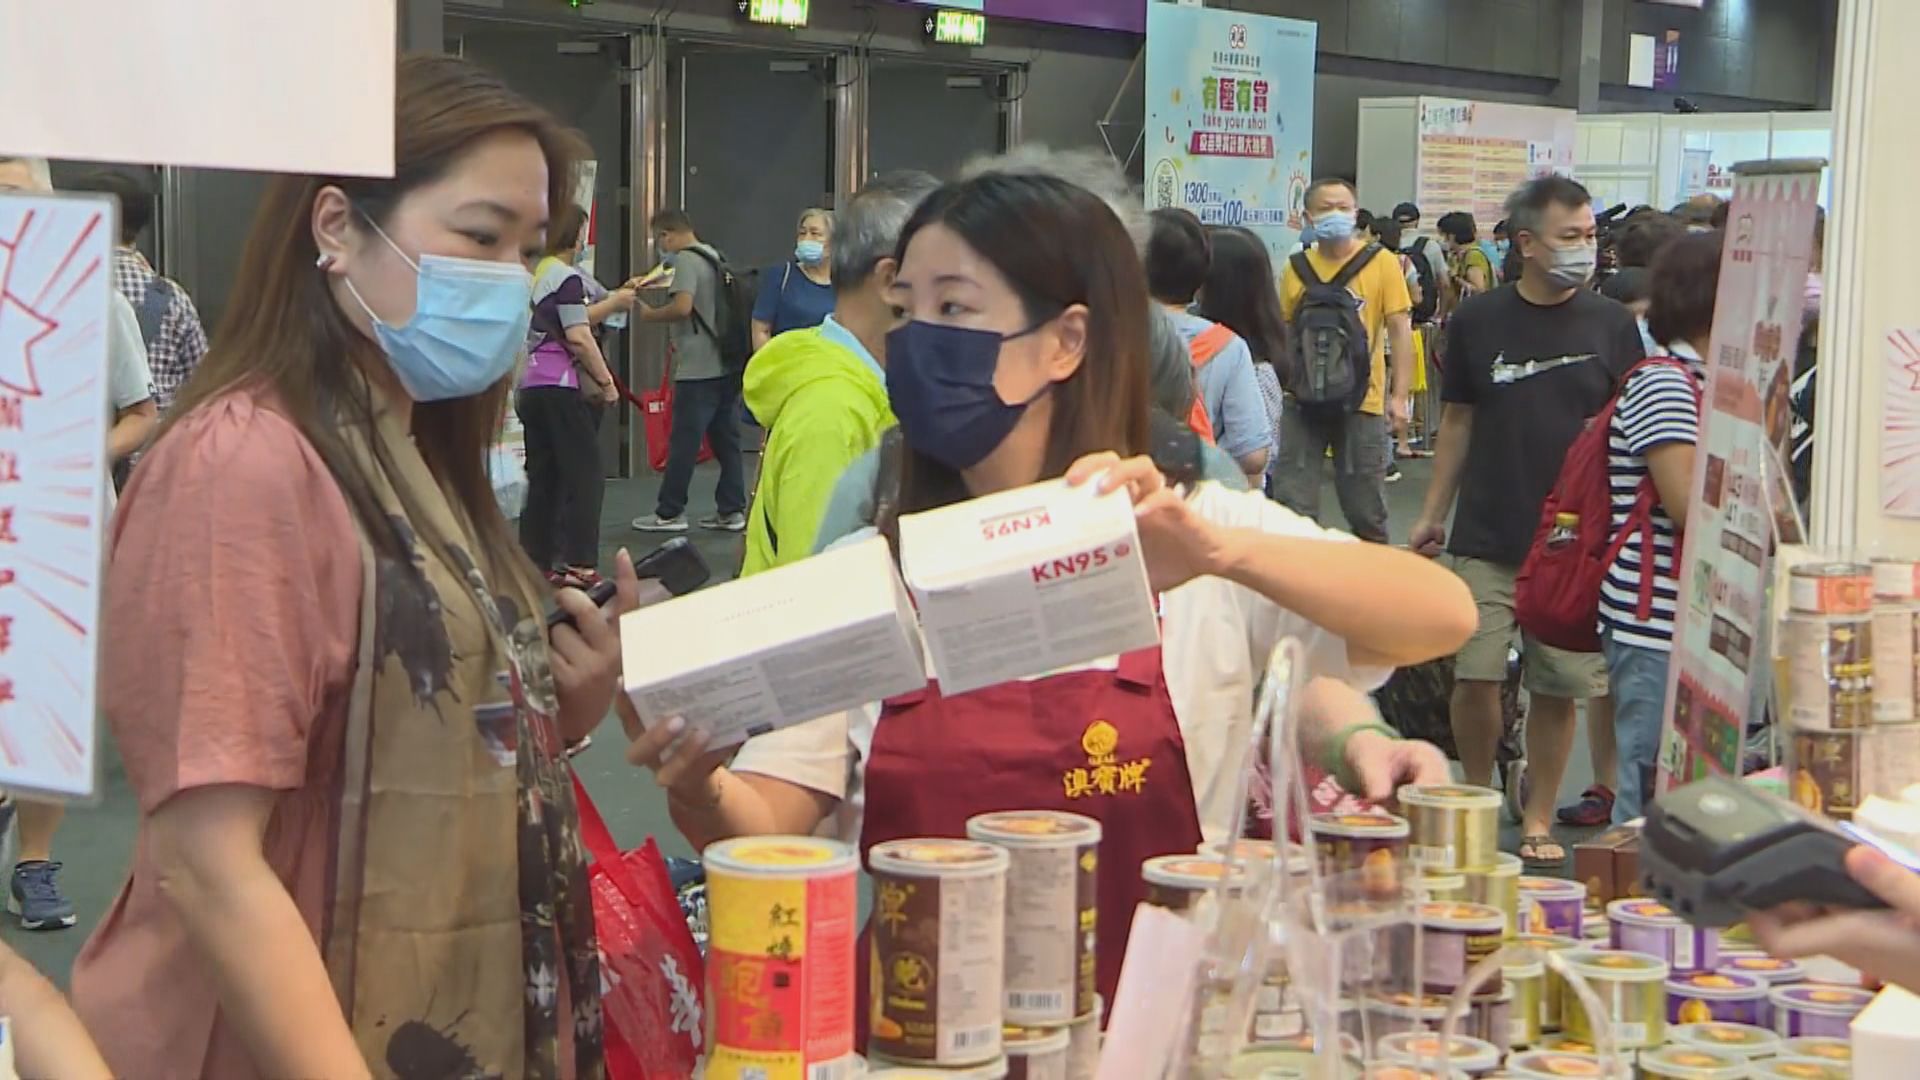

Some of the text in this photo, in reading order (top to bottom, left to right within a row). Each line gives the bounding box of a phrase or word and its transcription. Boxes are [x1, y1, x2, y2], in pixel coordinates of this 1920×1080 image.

[1203, 113, 1267, 131] take your shot
[982, 512, 1051, 541] KN95
[1031, 546, 1109, 584] KN95
